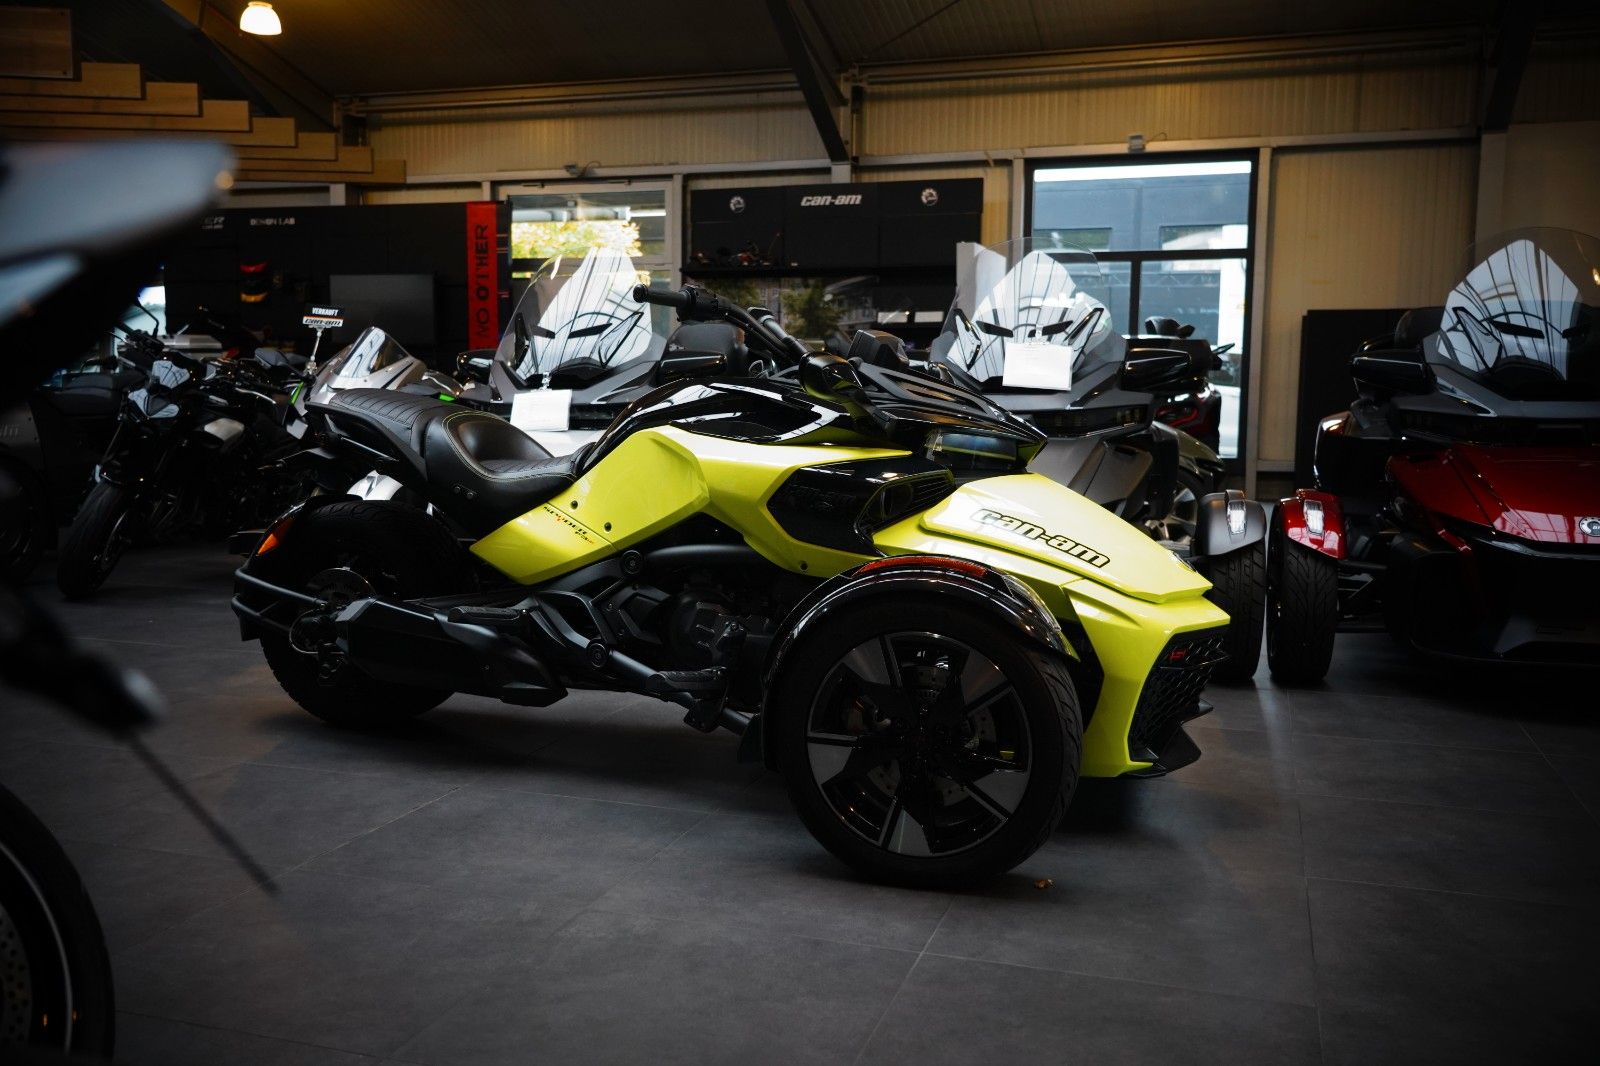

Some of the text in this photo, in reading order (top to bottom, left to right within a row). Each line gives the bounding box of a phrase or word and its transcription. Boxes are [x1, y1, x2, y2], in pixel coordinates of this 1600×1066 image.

[800, 194, 862, 207] can-am
[475, 224, 489, 301] OTHER
[969, 508, 1111, 569] can-am
